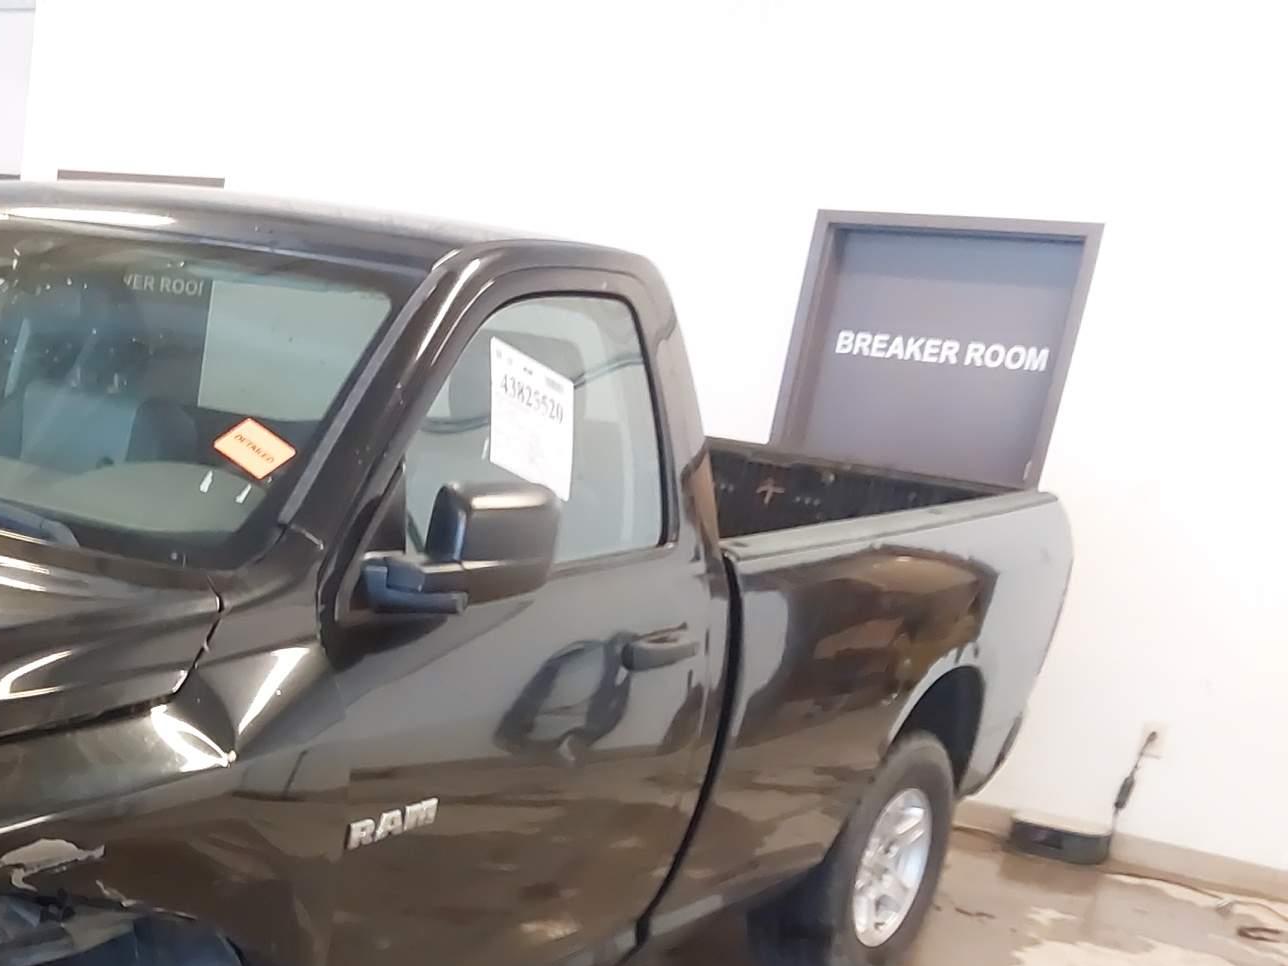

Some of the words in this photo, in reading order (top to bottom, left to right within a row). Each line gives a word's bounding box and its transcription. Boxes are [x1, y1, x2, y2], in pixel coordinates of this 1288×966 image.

[835, 330, 960, 364] BREAKER
[964, 341, 1050, 371] ROOM
[500, 373, 564, 425] 43825520
[345, 797, 439, 850] RAM
